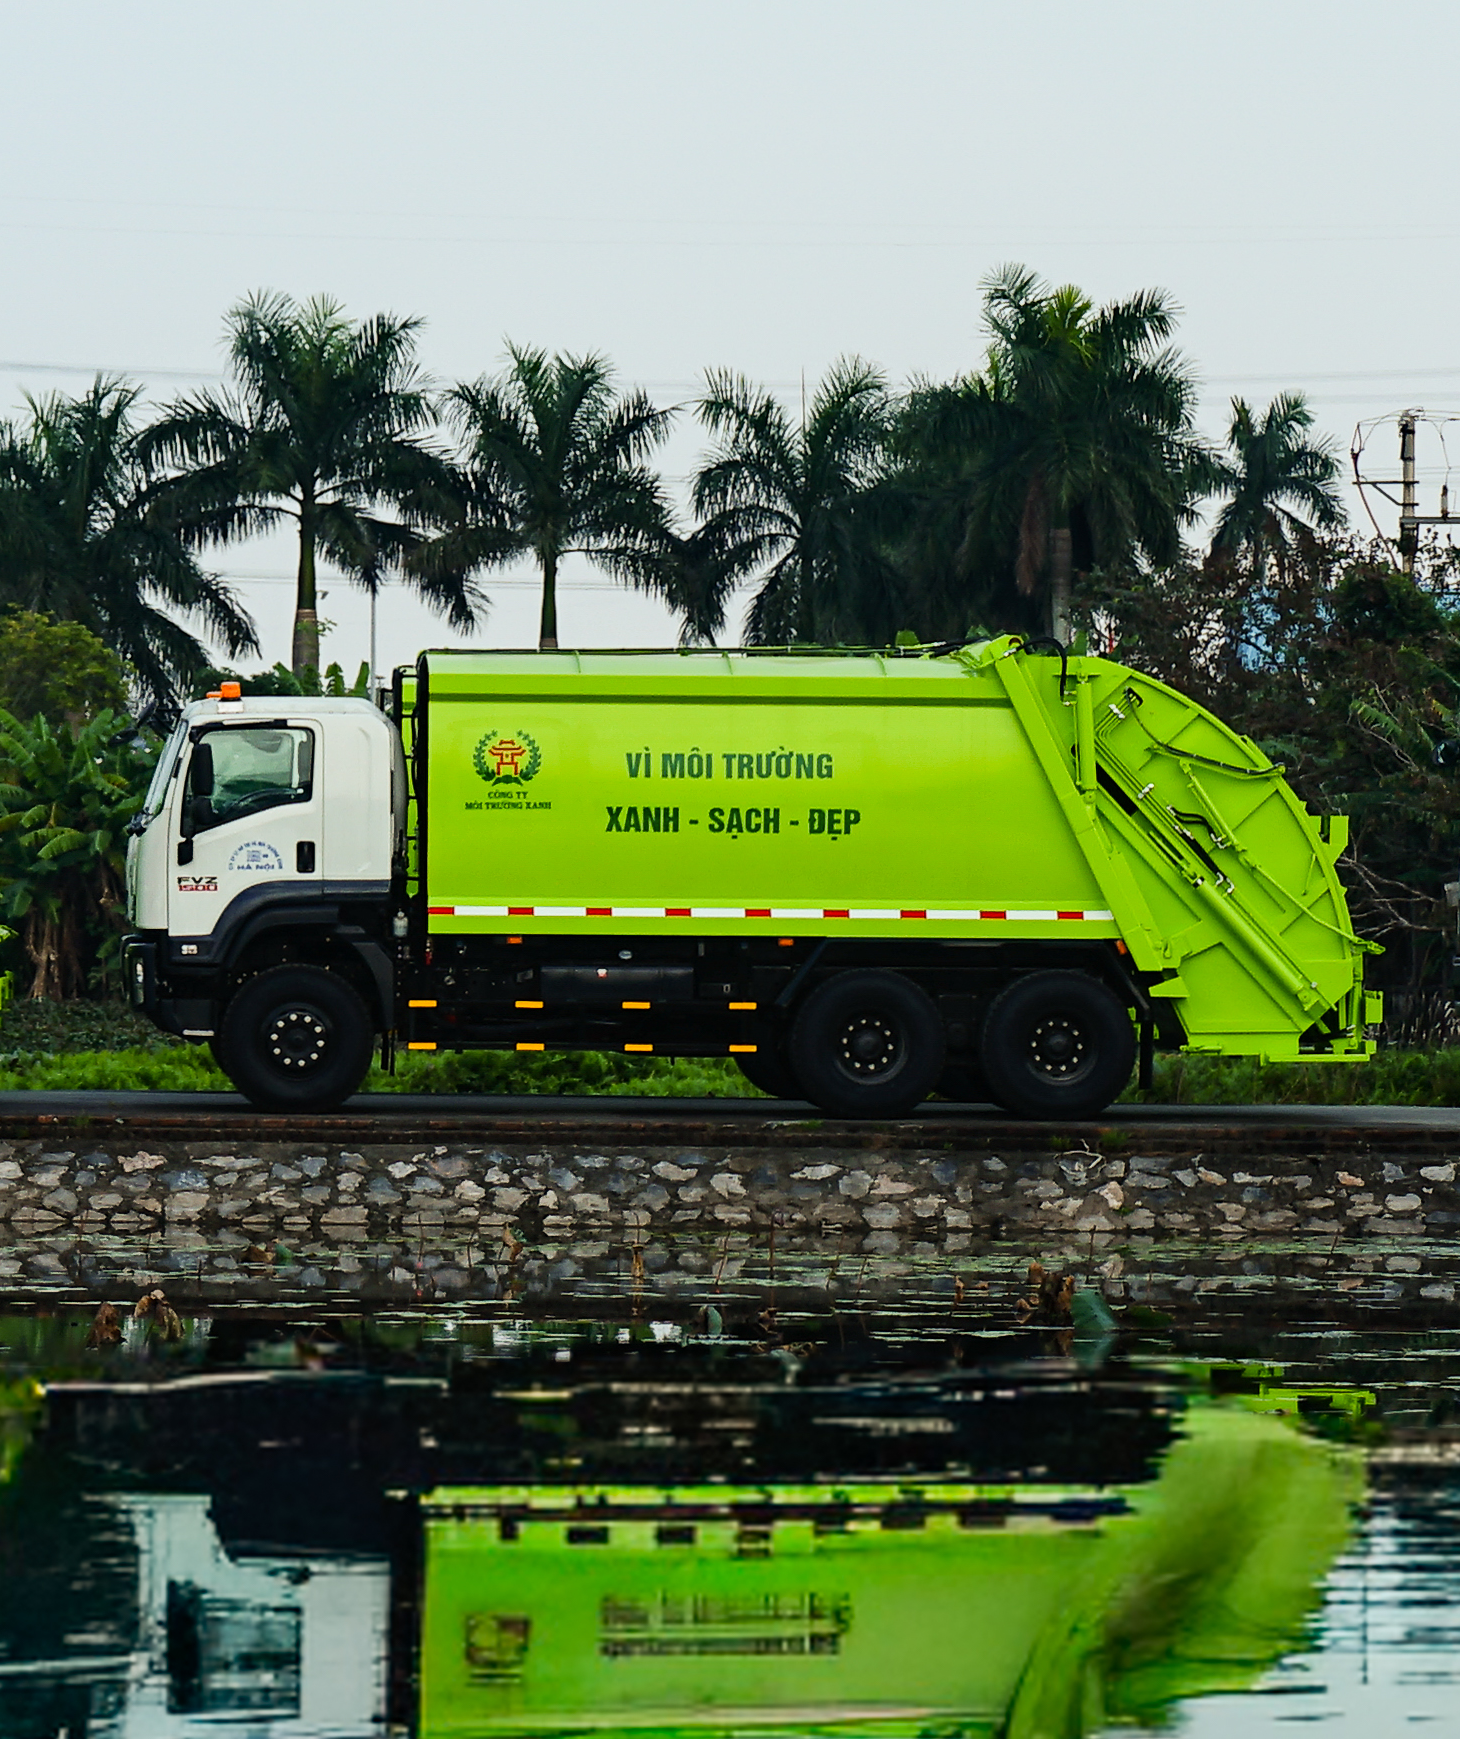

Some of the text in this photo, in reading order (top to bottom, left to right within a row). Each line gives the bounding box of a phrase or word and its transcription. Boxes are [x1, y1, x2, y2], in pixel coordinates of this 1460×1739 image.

[626, 746, 832, 779] VÌ MÔI TRƯỜNG
[516, 791, 528, 799] TY
[606, 807, 679, 833] XANH
[708, 808, 780, 839] SẠCH
[808, 809, 860, 841] ĐẸP
